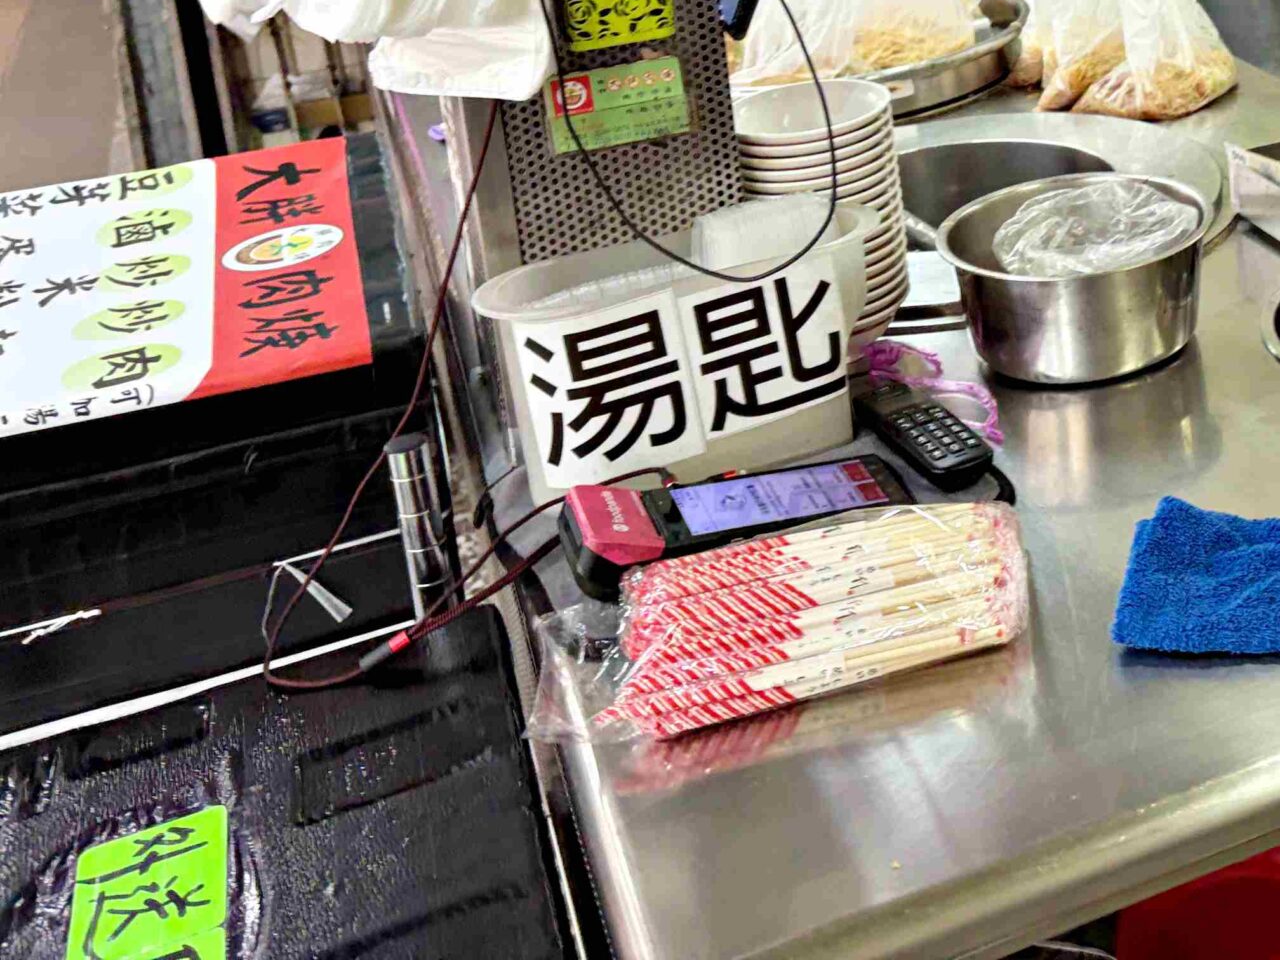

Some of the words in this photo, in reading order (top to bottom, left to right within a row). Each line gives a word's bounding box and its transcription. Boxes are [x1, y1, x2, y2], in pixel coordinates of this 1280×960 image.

[236, 162, 323, 225] 大胖
[524, 276, 848, 467] 湯匙
[600, 491, 625, 525] foodpanda
